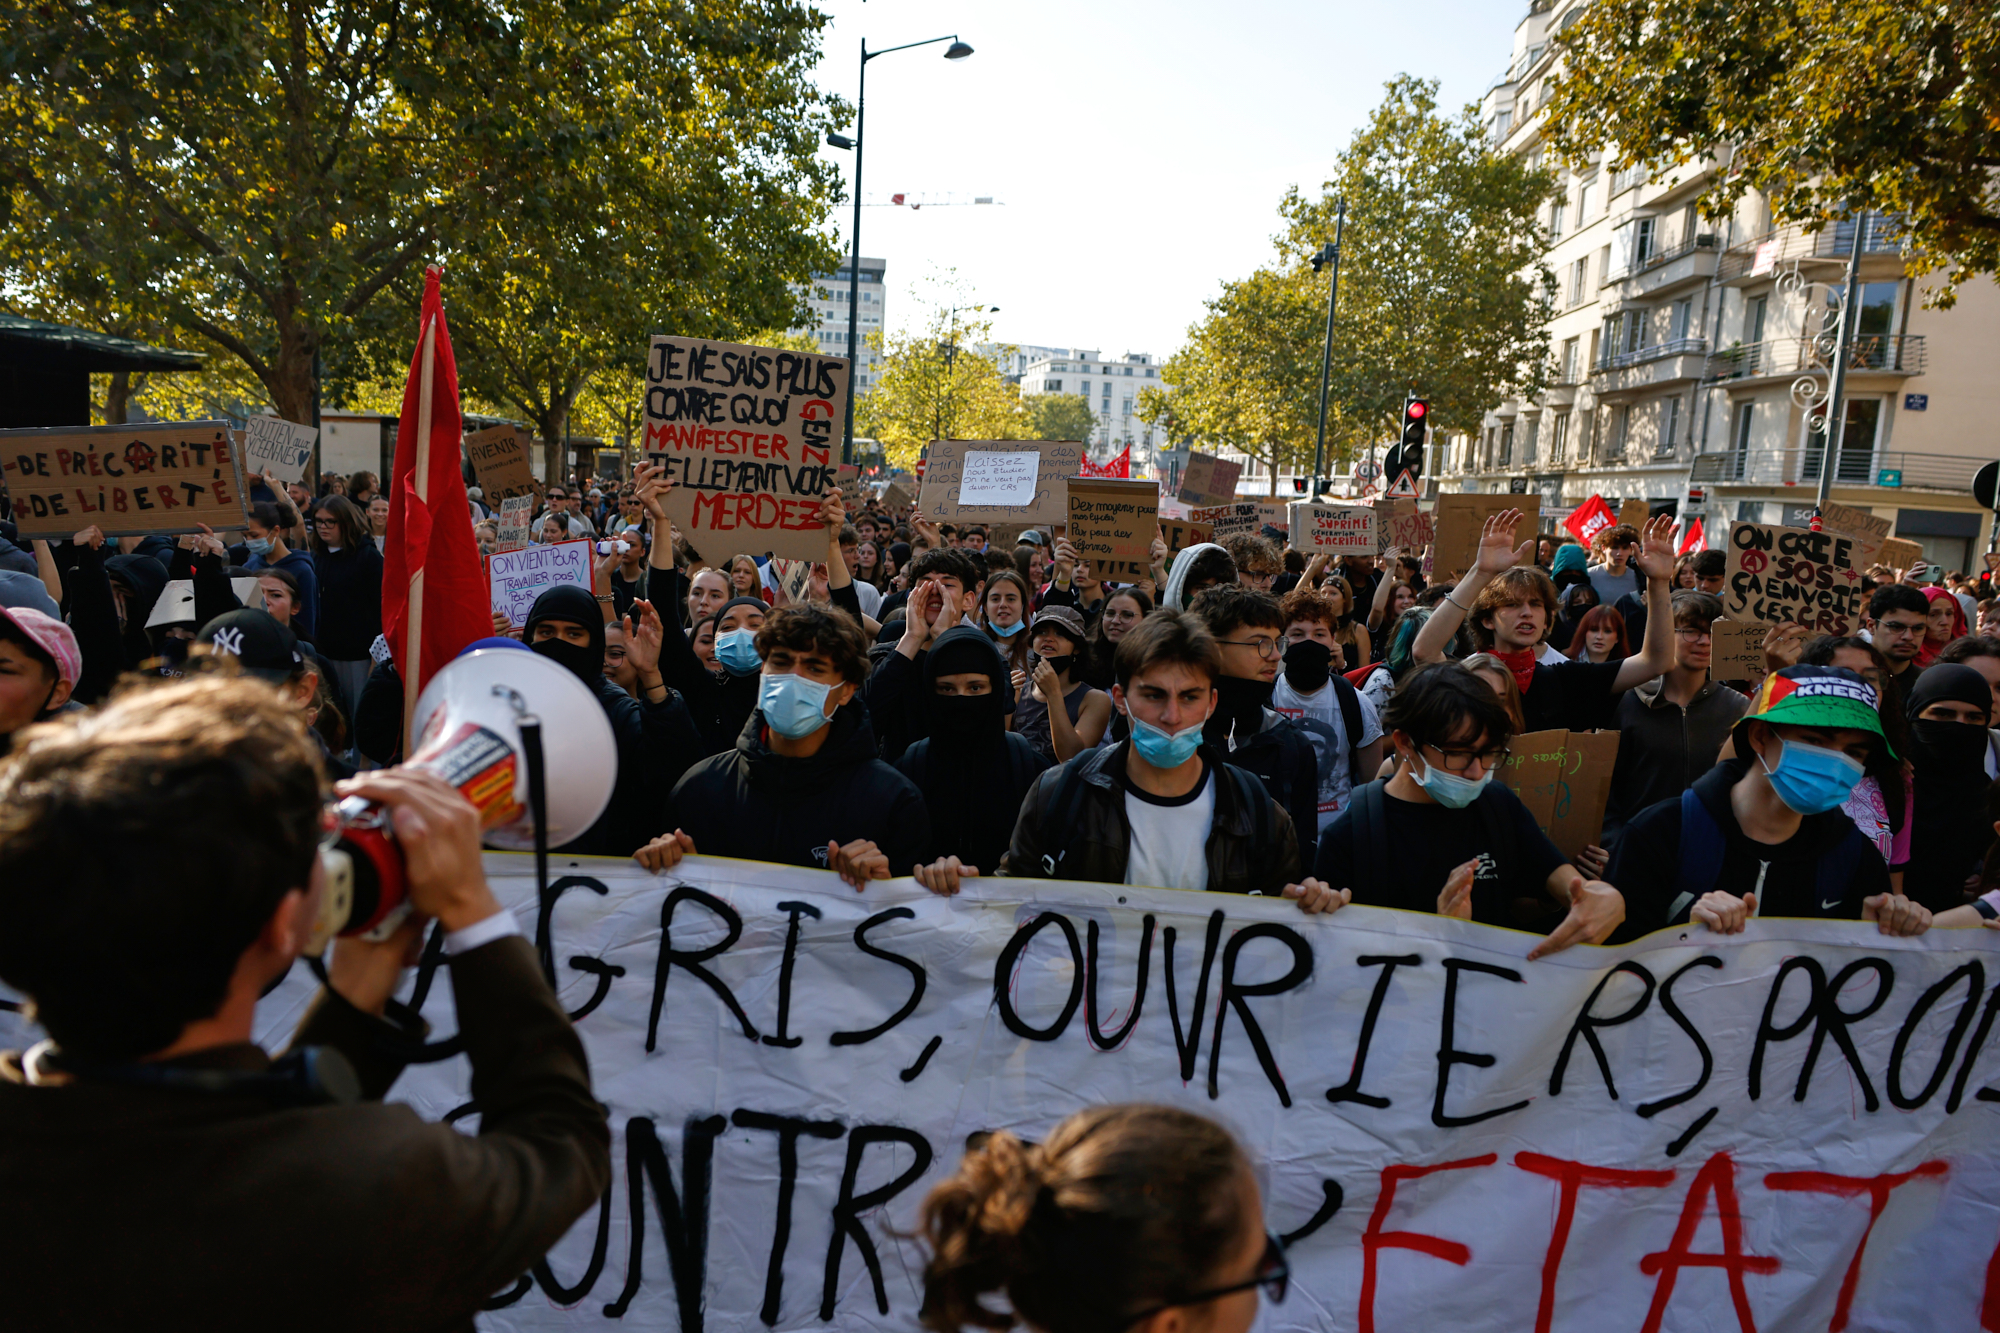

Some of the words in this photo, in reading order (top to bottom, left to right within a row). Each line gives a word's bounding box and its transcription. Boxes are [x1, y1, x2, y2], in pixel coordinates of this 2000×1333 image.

[648, 343, 685, 384] JE
[687, 344, 719, 384] NE
[774, 352, 844, 399] PLUS
[646, 385, 728, 425] CONTRE
[246, 417, 296, 446] SOUTIEN
[471, 437, 521, 462] AVENIR
[931, 443, 955, 458] Le
[1050, 445, 1075, 457] des
[648, 452, 784, 494] TELLEMENT
[928, 458, 965, 472] Mini
[1038, 456, 1081, 467] mentent
[965, 456, 1026, 469] Laissez
[928, 472, 959, 485] nos
[1036, 470, 1080, 482] ombent
[968, 482, 996, 491] devenir
[1016, 476, 1032, 484] pas
[691, 490, 827, 531] MERDEZ
[933, 502, 949, 516] de
[1071, 497, 1095, 512] Des
[1095, 502, 1136, 515] moyens
[1137, 505, 1157, 519] pour
[1072, 513, 1089, 521] nos
[1235, 504, 1255, 516] POUR
[1313, 509, 1351, 520] BUDGET
[1793, 509, 1811, 520] SG
[1822, 500, 1852, 523] VOUS
[1071, 522, 1087, 537] Pas
[1089, 529, 1112, 540] pour
[1114, 529, 1133, 539] des
[1733, 525, 1774, 551] ON
[1778, 532, 1853, 569] CRIE
[492, 557, 514, 574] ON
[550, 547, 579, 567] POUR
[508, 590, 535, 602] POUR
[1765, 577, 1861, 617] ENVOIE
[1753, 597, 1794, 624] LES
[1797, 606, 1850, 637] CRS
[211, 626, 245, 656] NY
[993, 908, 1726, 1158] OUVRIERS,
